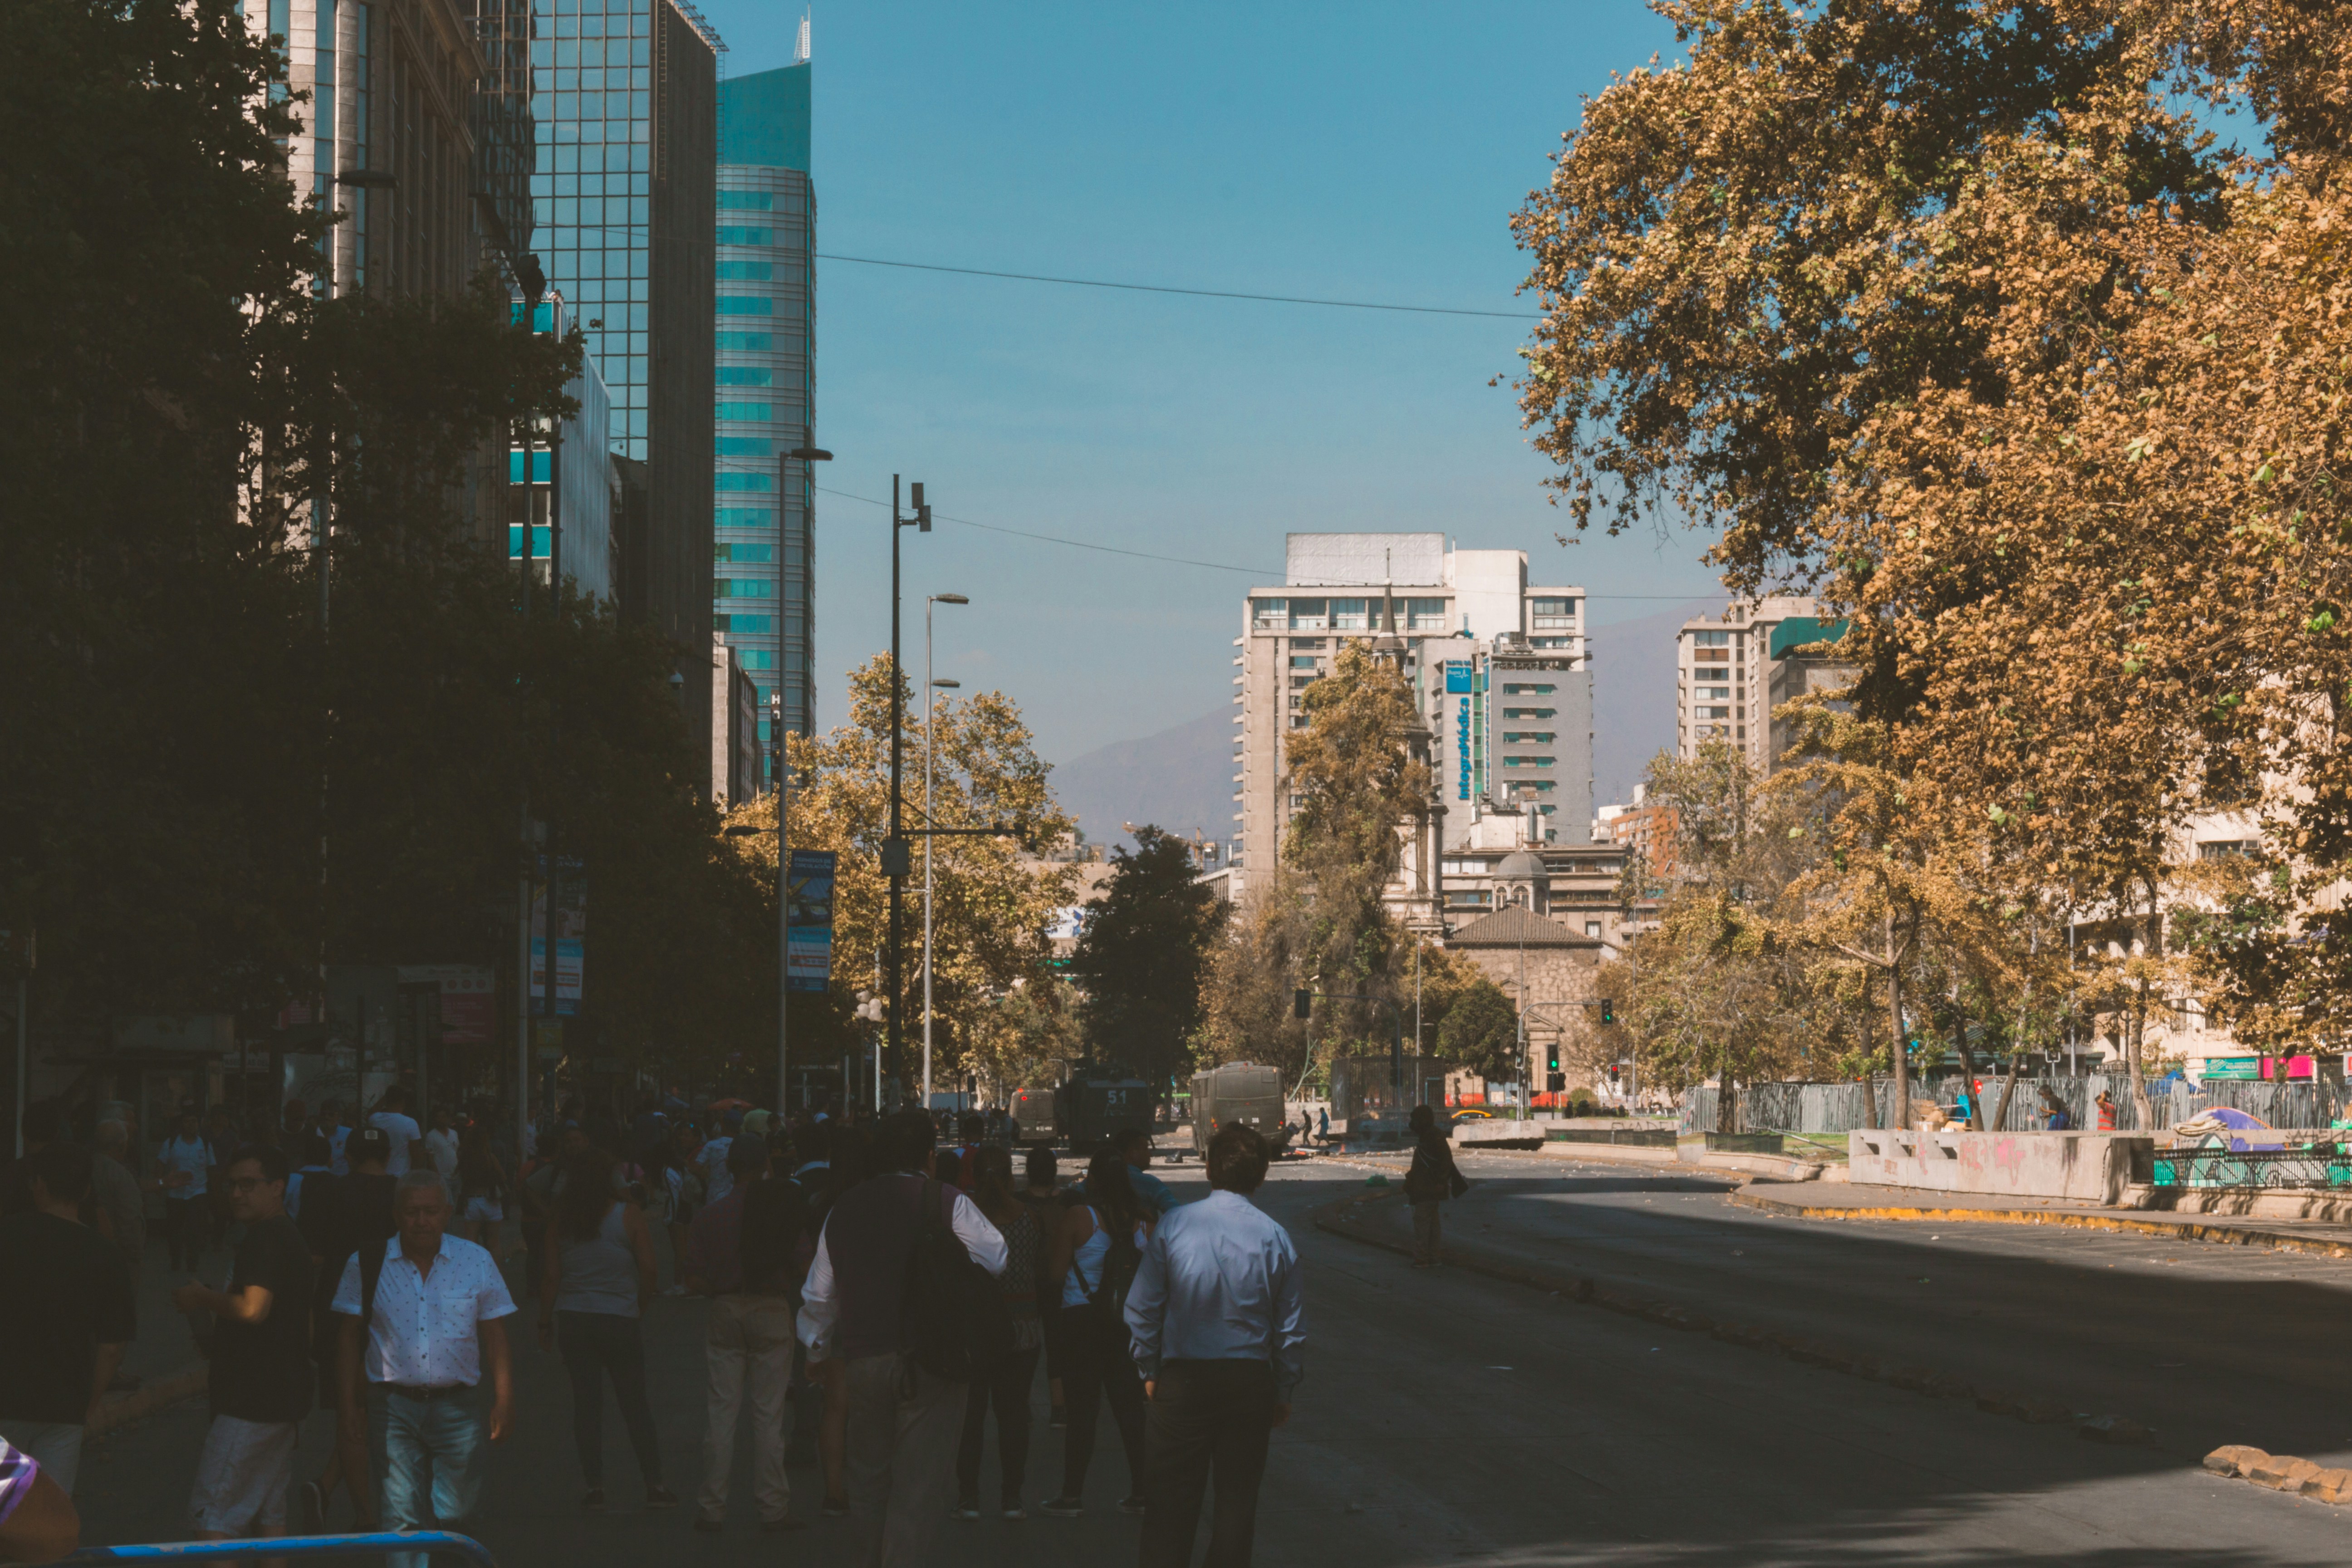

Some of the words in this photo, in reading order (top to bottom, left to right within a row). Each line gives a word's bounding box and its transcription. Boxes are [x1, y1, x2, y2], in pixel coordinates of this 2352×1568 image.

[771, 694, 780, 766] HOTEL
[1457, 697, 1472, 800] IntegraMédica
[1108, 1090, 1126, 1104] 51
